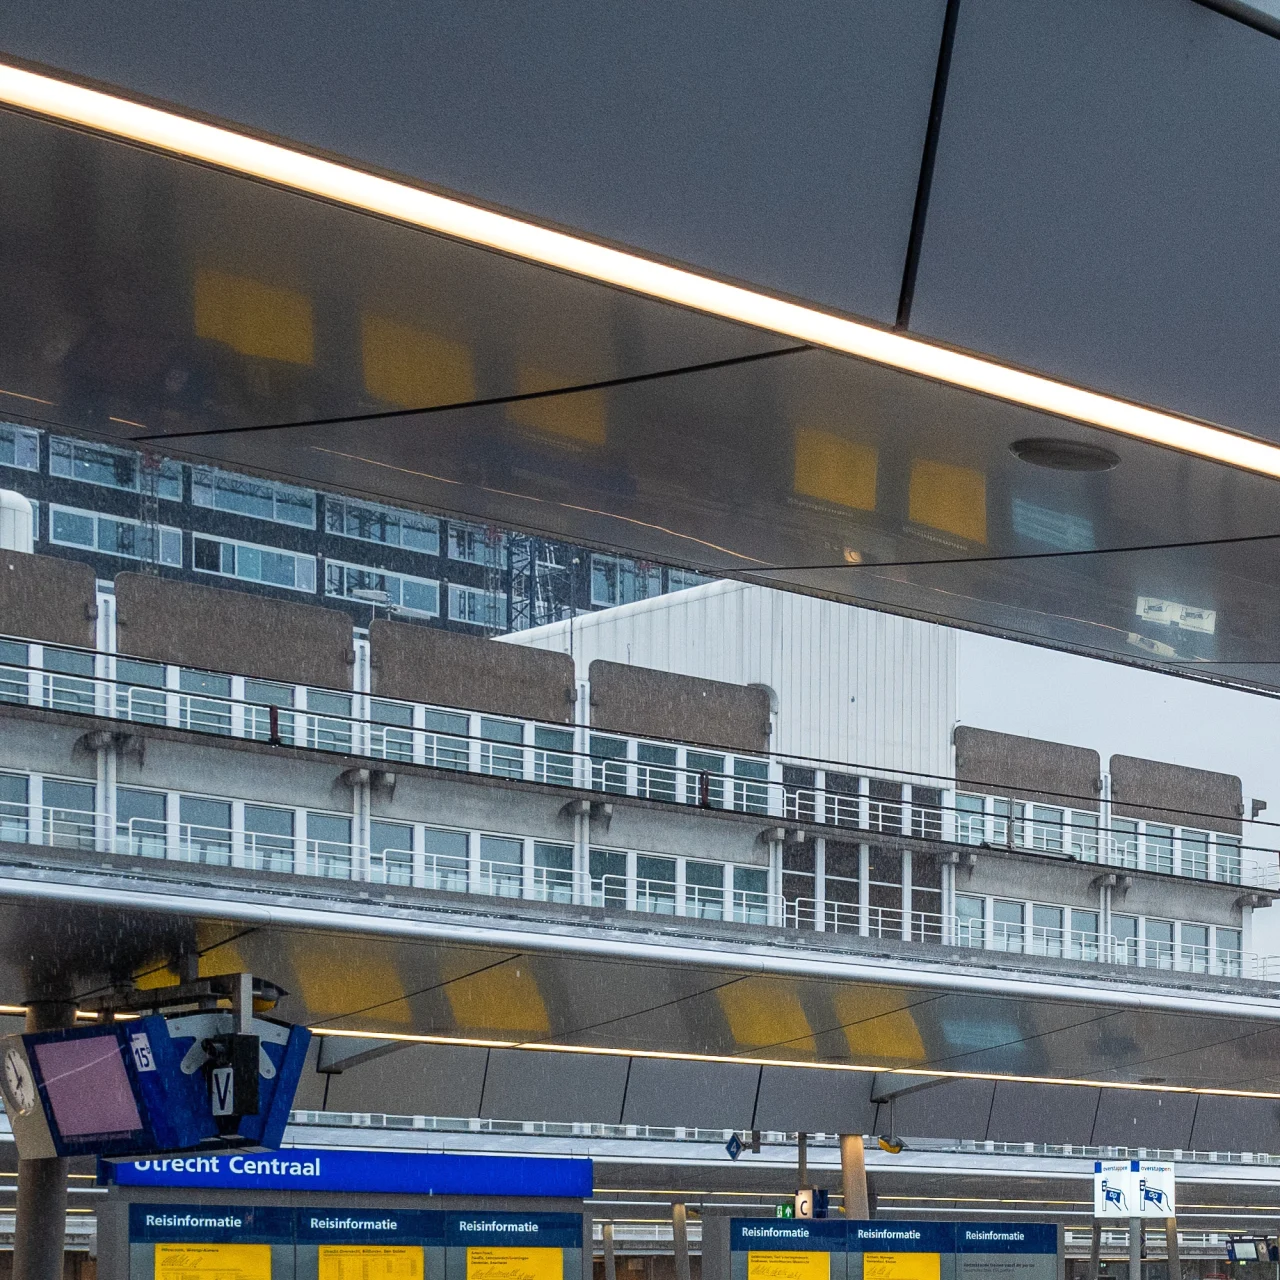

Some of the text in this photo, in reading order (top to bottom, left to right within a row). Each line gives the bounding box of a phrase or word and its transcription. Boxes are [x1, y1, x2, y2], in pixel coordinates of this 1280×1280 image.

[214, 1072, 231, 1111] V
[730, 1143, 737, 1154] 4
[134, 1156, 320, 1177] Utrecht Centraal
[800, 1200, 808, 1216] C
[146, 1214, 242, 1228] Reisinformatie
[310, 1217, 398, 1231] Reisinformatie
[459, 1220, 539, 1233] Reisinformatie
[741, 1227, 810, 1238] Reisinformatie
[857, 1229, 921, 1240] Reisinformatie
[966, 1230, 1025, 1241] Reisinformatie
